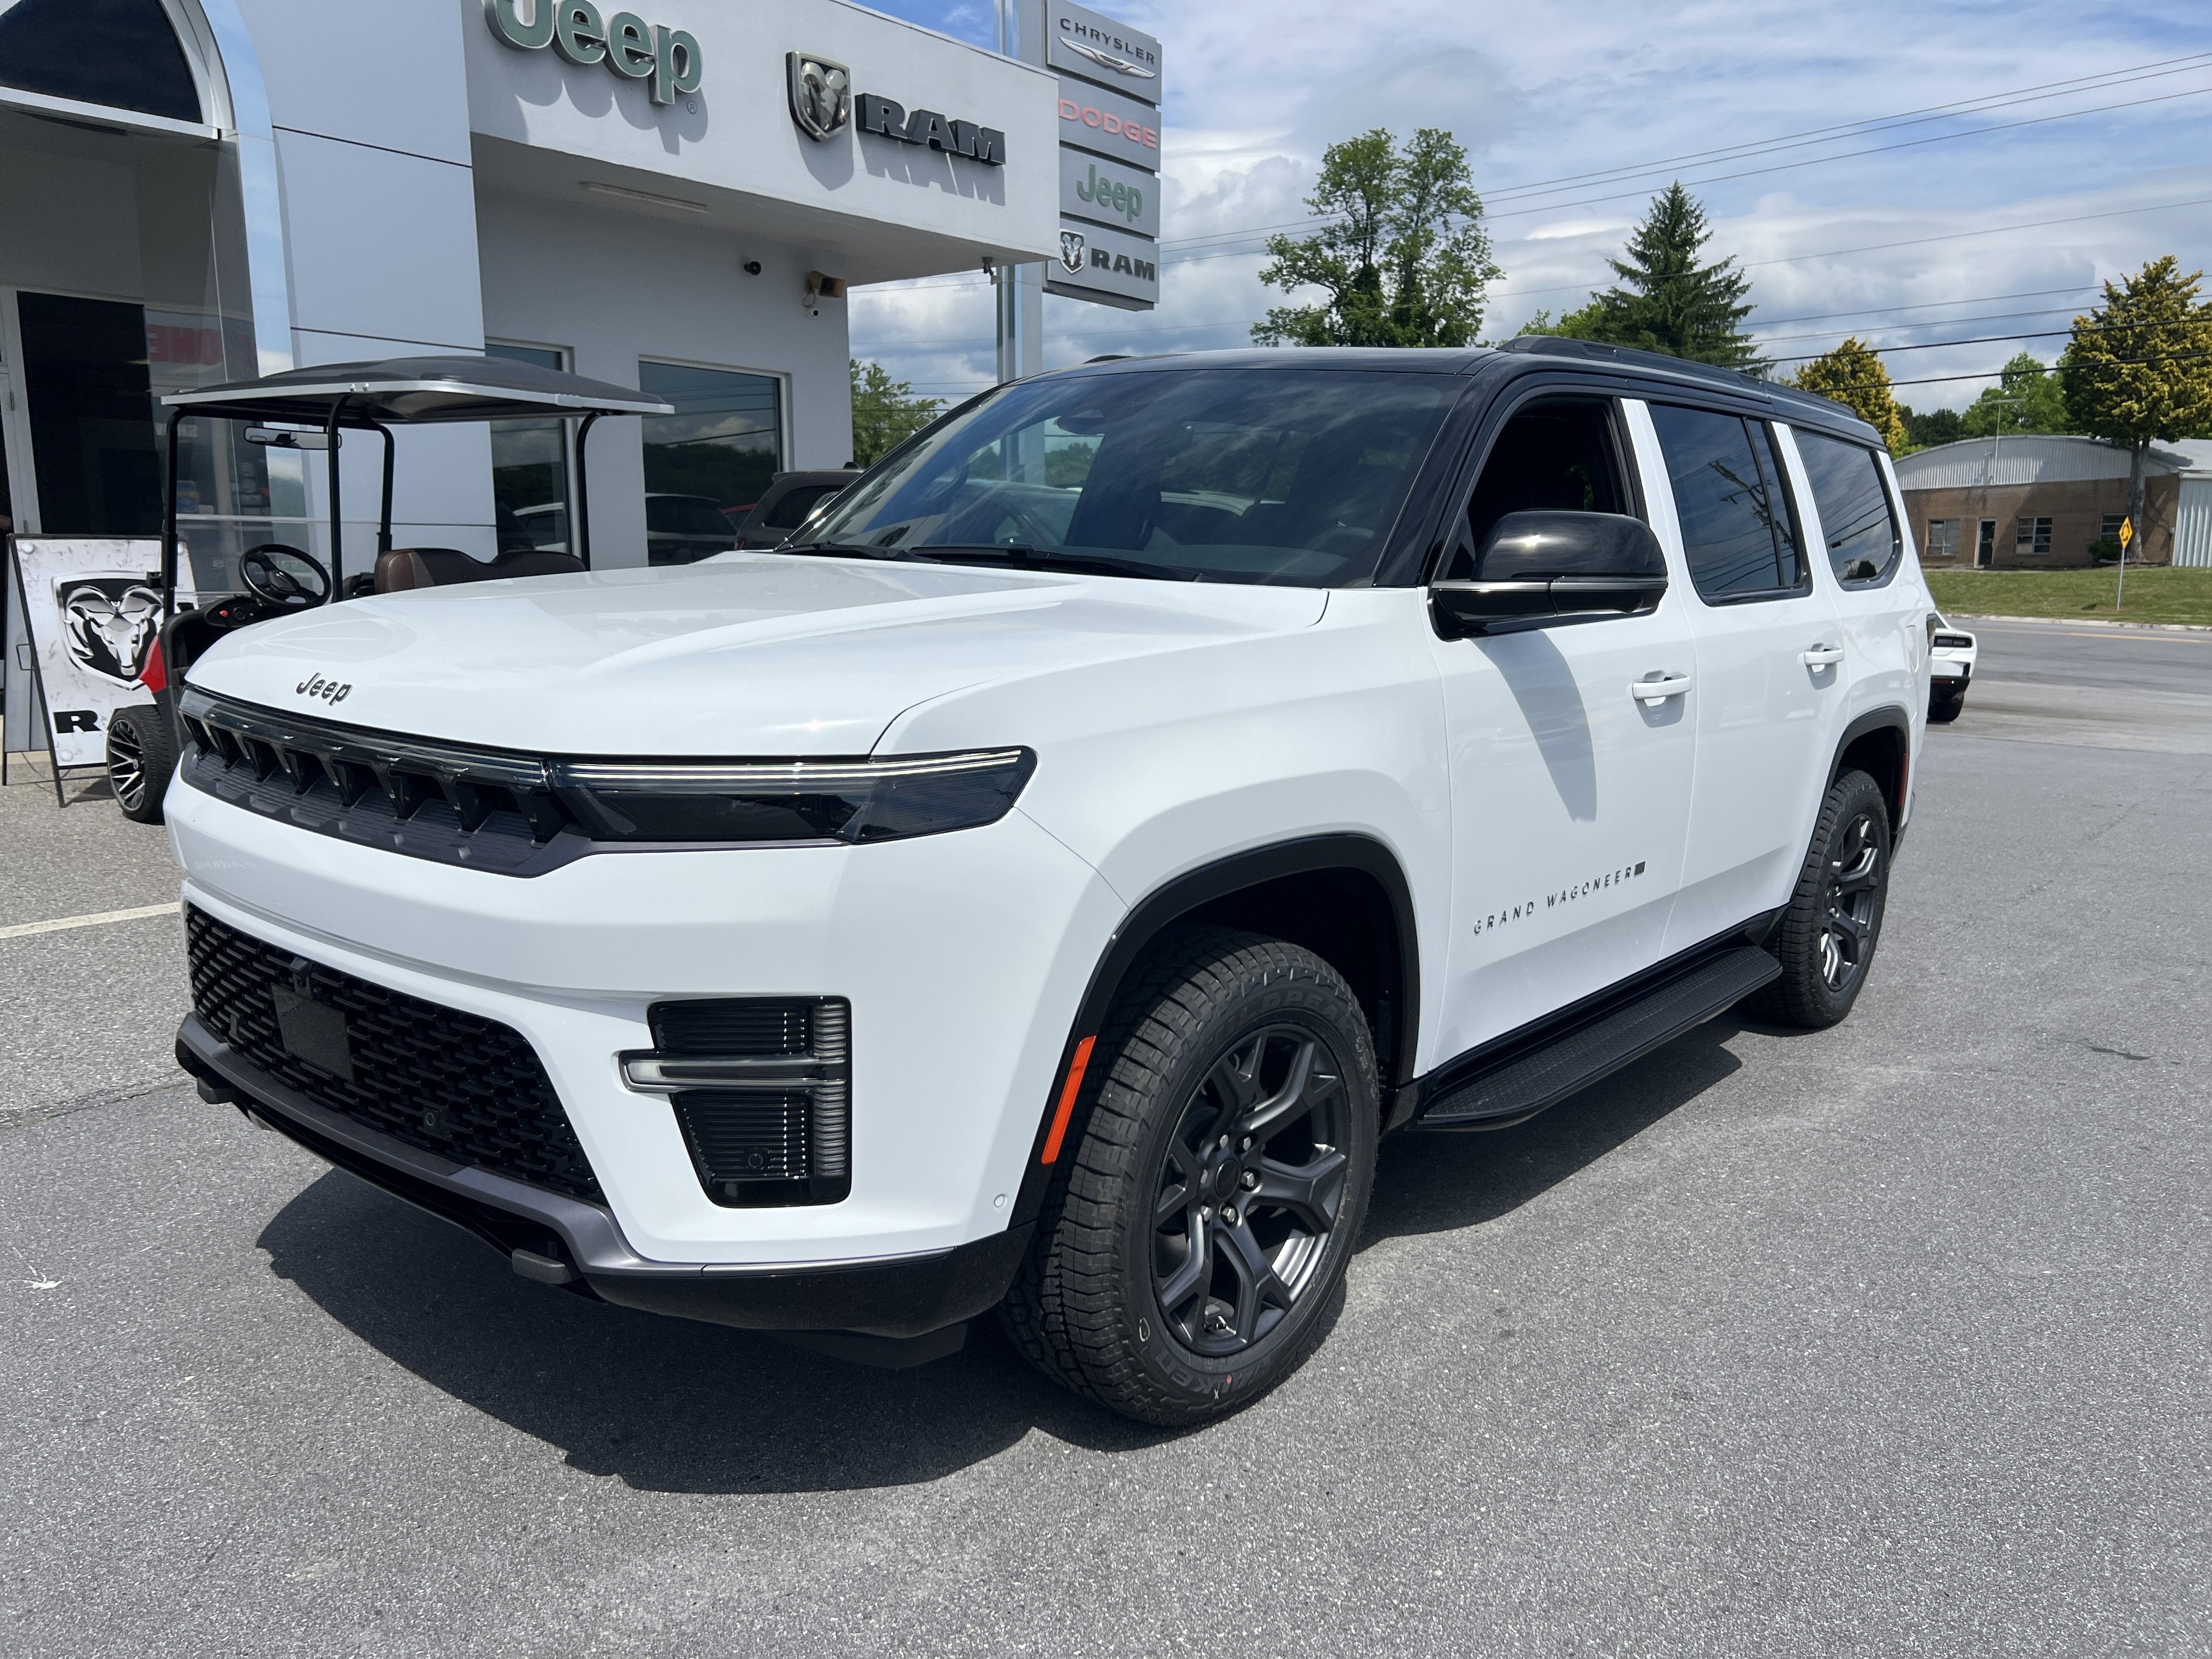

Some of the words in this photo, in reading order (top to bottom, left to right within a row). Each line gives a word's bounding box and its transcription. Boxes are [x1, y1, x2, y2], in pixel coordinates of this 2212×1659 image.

[1059, 18, 1155, 65] CHRYSLER
[855, 93, 1006, 166] RAM
[1058, 98, 1157, 149] DODGE
[1076, 163, 1143, 222] Jeep
[1091, 247, 1155, 281] RAM
[296, 672, 353, 706] Jeep
[1474, 901, 1534, 935] GRAND
[1546, 866, 1632, 909] WAGONEER
